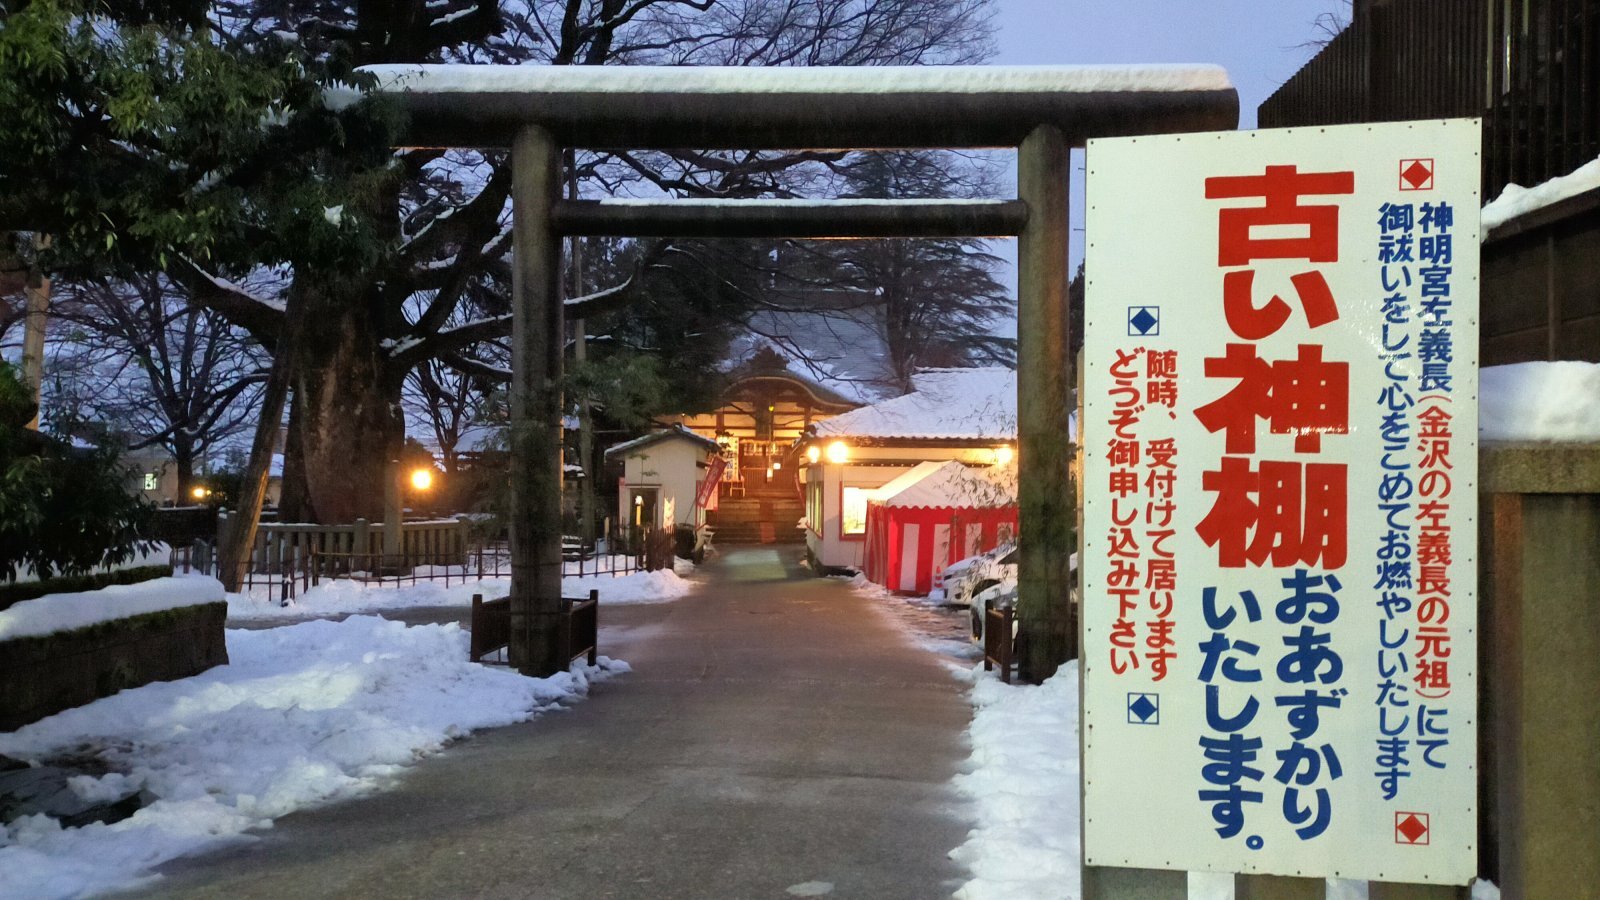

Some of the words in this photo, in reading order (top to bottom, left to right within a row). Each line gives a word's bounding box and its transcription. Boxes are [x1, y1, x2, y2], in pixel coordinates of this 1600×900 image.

[1106, 346, 1145, 675] どうぞ御申し込み下さい
[1194, 165, 1355, 570] 古い神棚
[1198, 586, 1264, 850] いたします。
[1274, 569, 1347, 840] おあずかり
